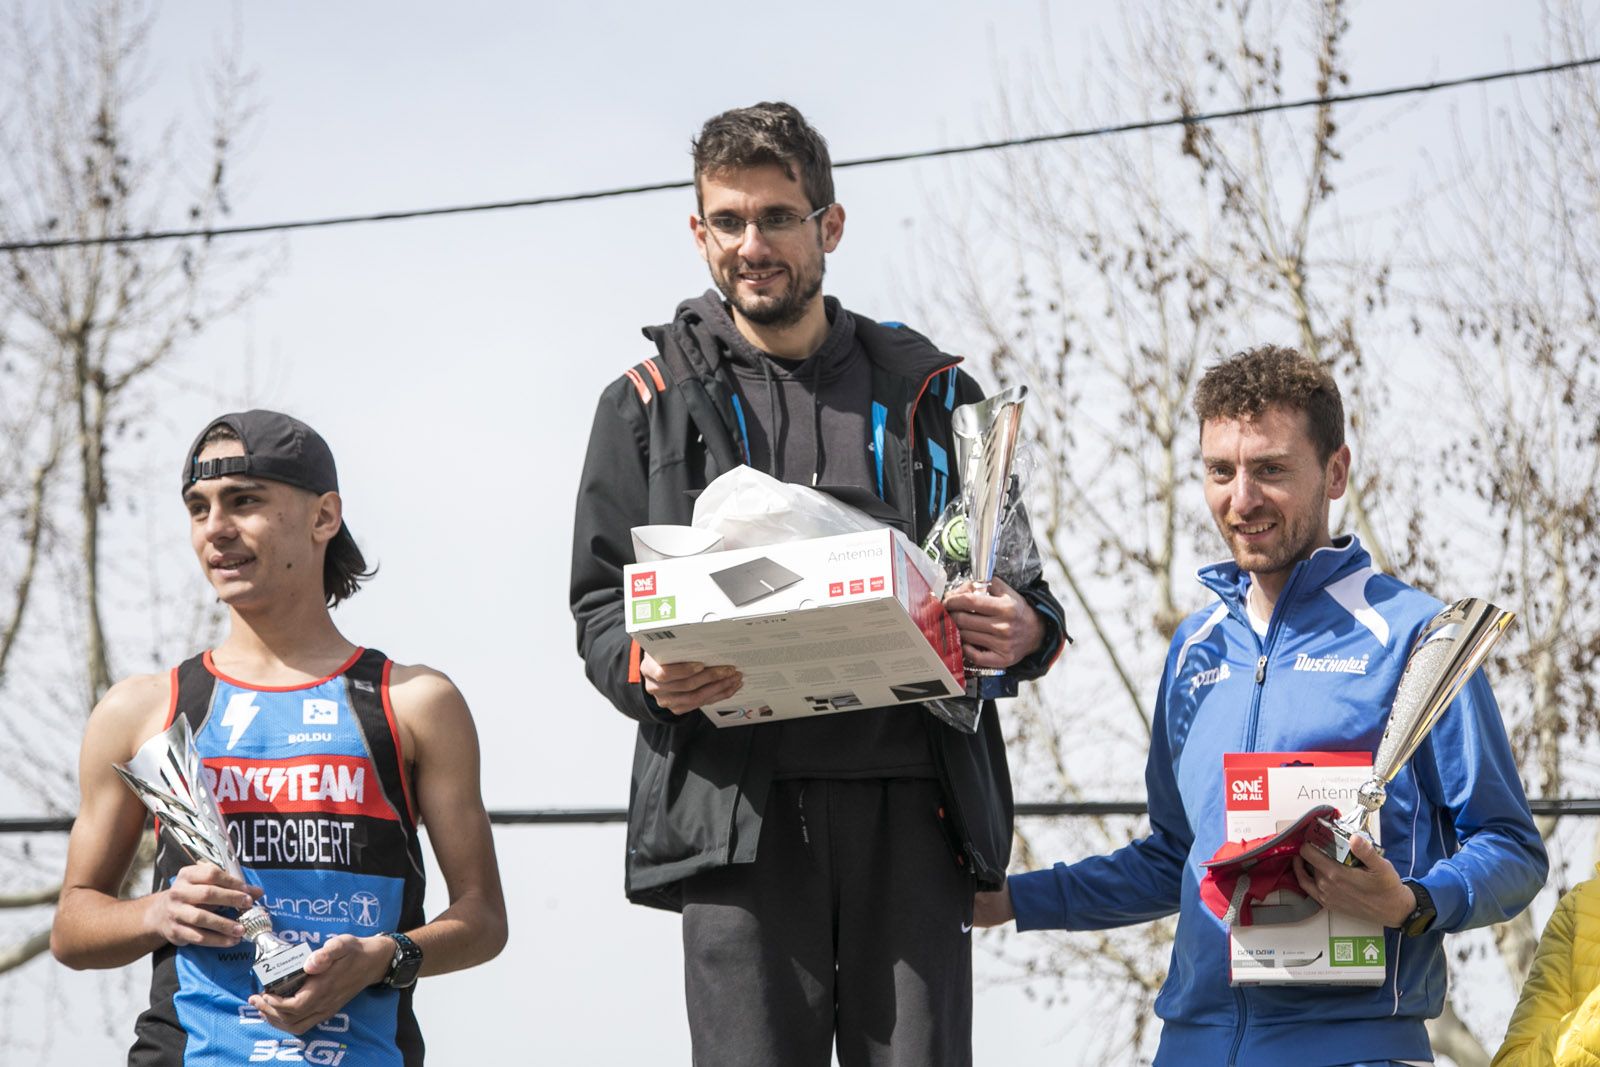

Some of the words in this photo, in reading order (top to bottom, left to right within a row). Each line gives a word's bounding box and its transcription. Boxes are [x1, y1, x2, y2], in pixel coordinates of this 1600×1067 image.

[827, 548, 883, 563] Antenna
[288, 733, 332, 744] BOLDU
[287, 764, 365, 804] TEAM
[1232, 780, 1263, 793] ONE
[1232, 793, 1248, 801] FOR
[1297, 785, 1358, 800] Antenn
[227, 819, 354, 866] OLERGIBERT
[263, 893, 348, 916] unner's
[277, 930, 320, 944] ON
